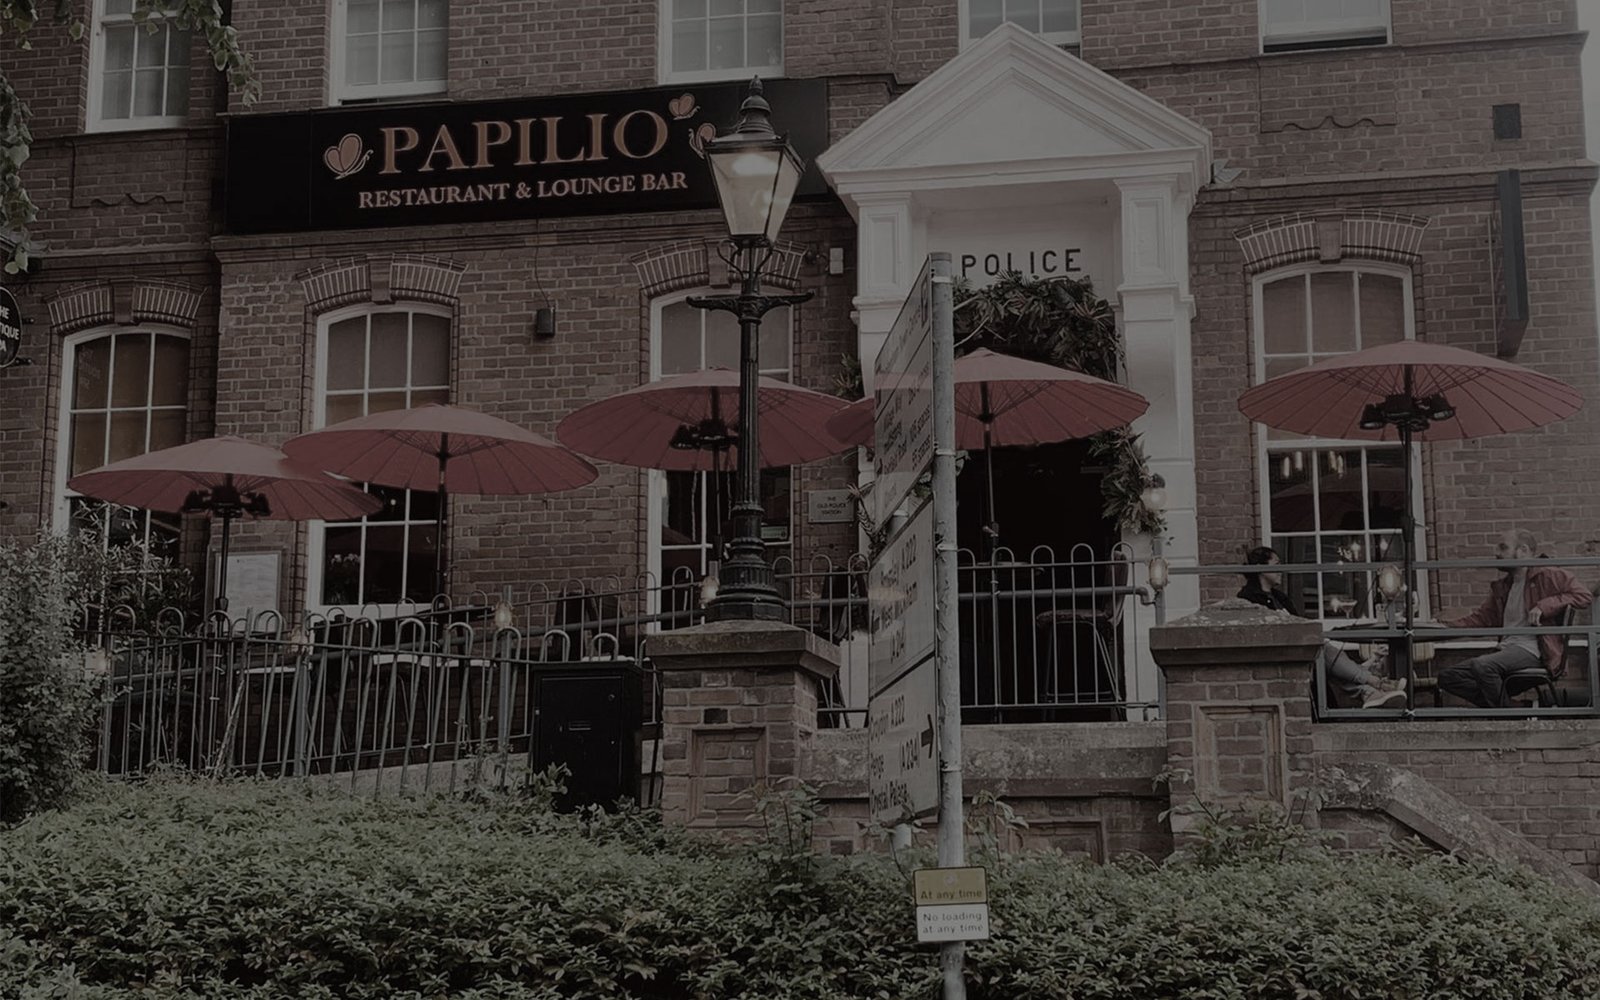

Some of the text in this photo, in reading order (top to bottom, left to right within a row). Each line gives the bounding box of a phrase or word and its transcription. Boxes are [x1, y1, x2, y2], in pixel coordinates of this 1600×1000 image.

[378, 109, 668, 175] PAPILIO
[358, 171, 689, 209] RESTAURANT & LOUNGE BAR
[961, 248, 1081, 278] POLICE
[901, 535, 917, 569] A222
[891, 694, 905, 728] A222
[870, 751, 884, 780] Penge
[921, 889, 982, 899] At any time
[922, 923, 983, 934] at any time
[923, 911, 982, 921] No loading
